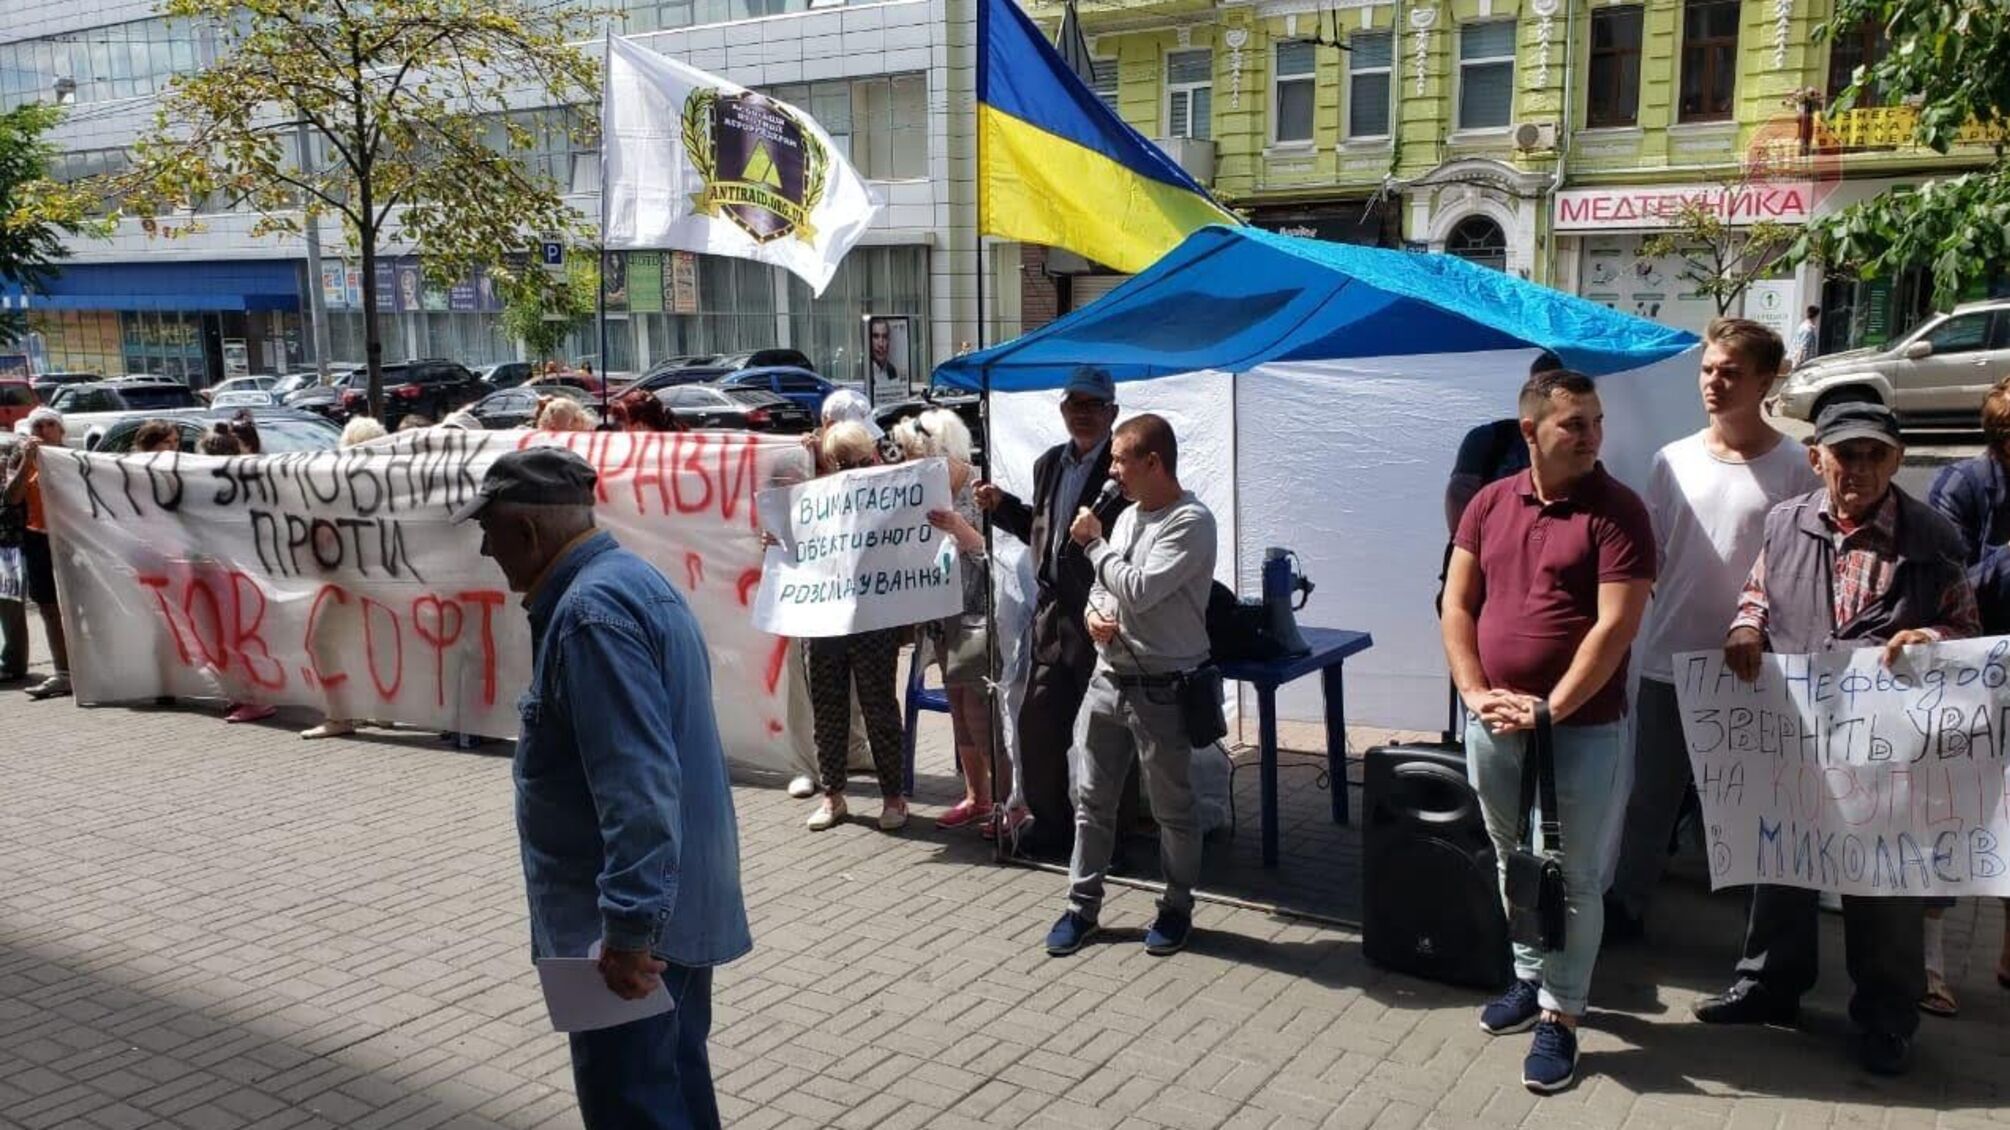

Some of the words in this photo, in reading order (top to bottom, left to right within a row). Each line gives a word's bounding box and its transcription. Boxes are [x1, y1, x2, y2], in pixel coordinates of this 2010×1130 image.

[1560, 190, 1804, 222] МЕДТЕХНИКА
[211, 432, 489, 516] ЗАМОВНИК
[799, 483, 925, 525] ВИМАГАЄМО
[250, 509, 427, 584] ПРОТИ
[1697, 763, 1745, 806] НА
